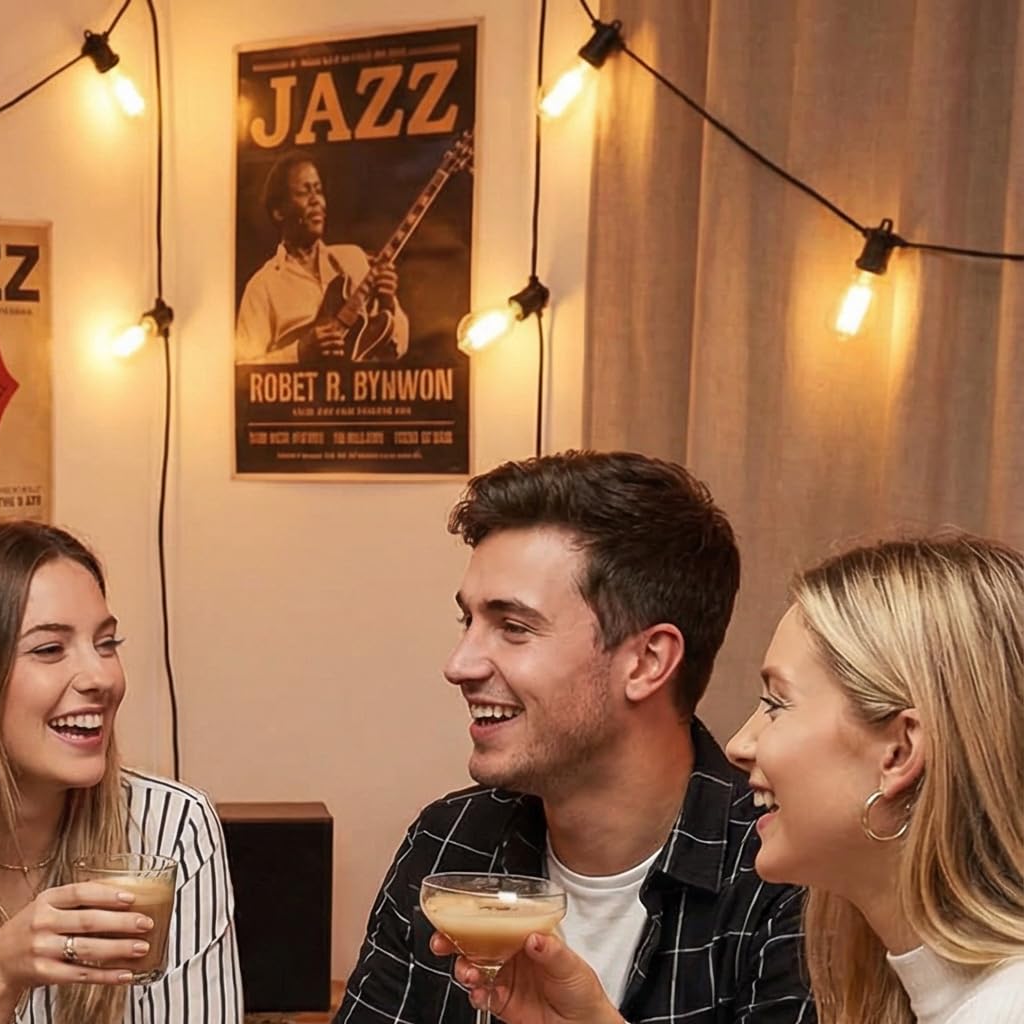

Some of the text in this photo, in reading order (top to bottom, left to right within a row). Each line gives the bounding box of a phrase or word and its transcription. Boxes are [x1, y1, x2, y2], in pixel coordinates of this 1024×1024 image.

[250, 59, 459, 148] JAZZ
[250, 372, 319, 402] ROBET
[354, 368, 454, 401] BYNWON
